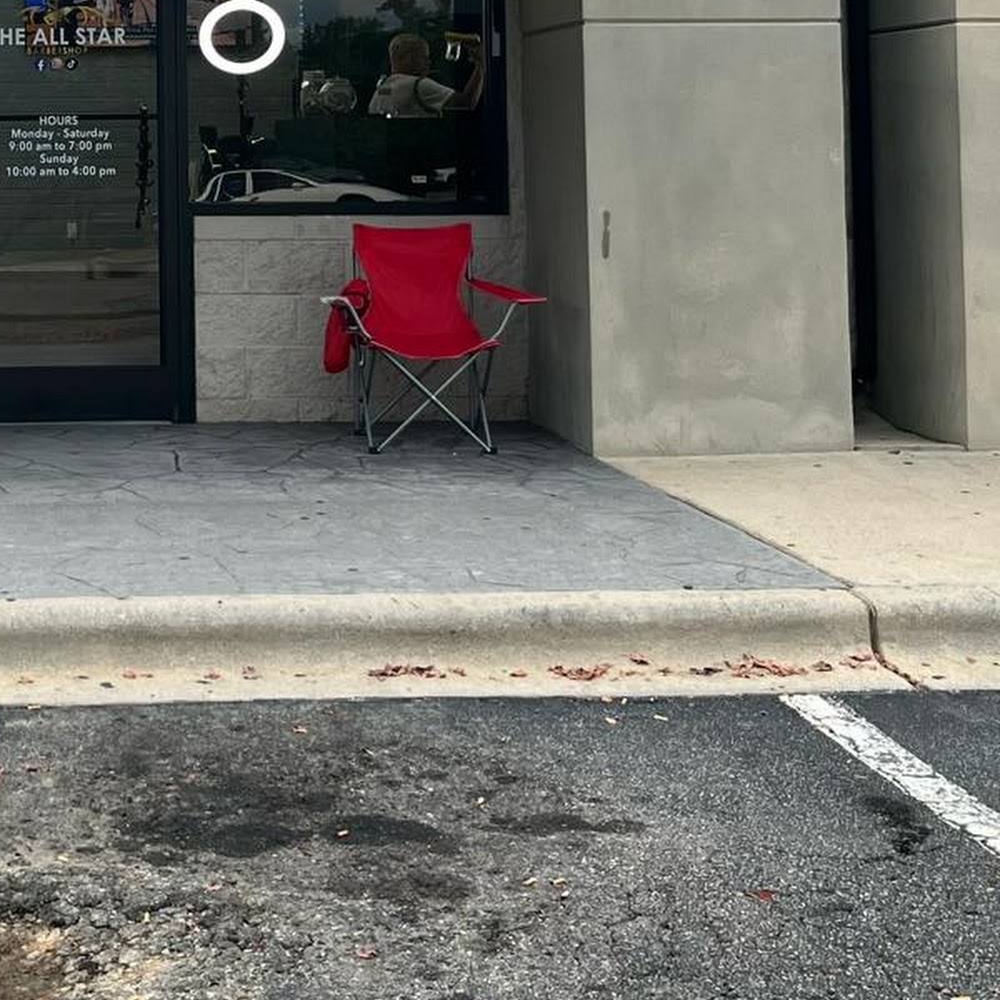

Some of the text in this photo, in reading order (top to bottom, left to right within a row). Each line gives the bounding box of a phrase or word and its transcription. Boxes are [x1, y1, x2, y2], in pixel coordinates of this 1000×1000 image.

[32, 27, 70, 46] ALL
[75, 27, 126, 46] STAR
[39, 115, 79, 126] HOURS
[10, 128, 54, 141] Monday
[63, 127, 110, 141] Saturday
[8, 140, 113, 153] 9:00 am to 7:00 pm
[39, 153, 79, 166] Sunday
[6, 165, 117, 179] 10:00 am to 4:00 pm
